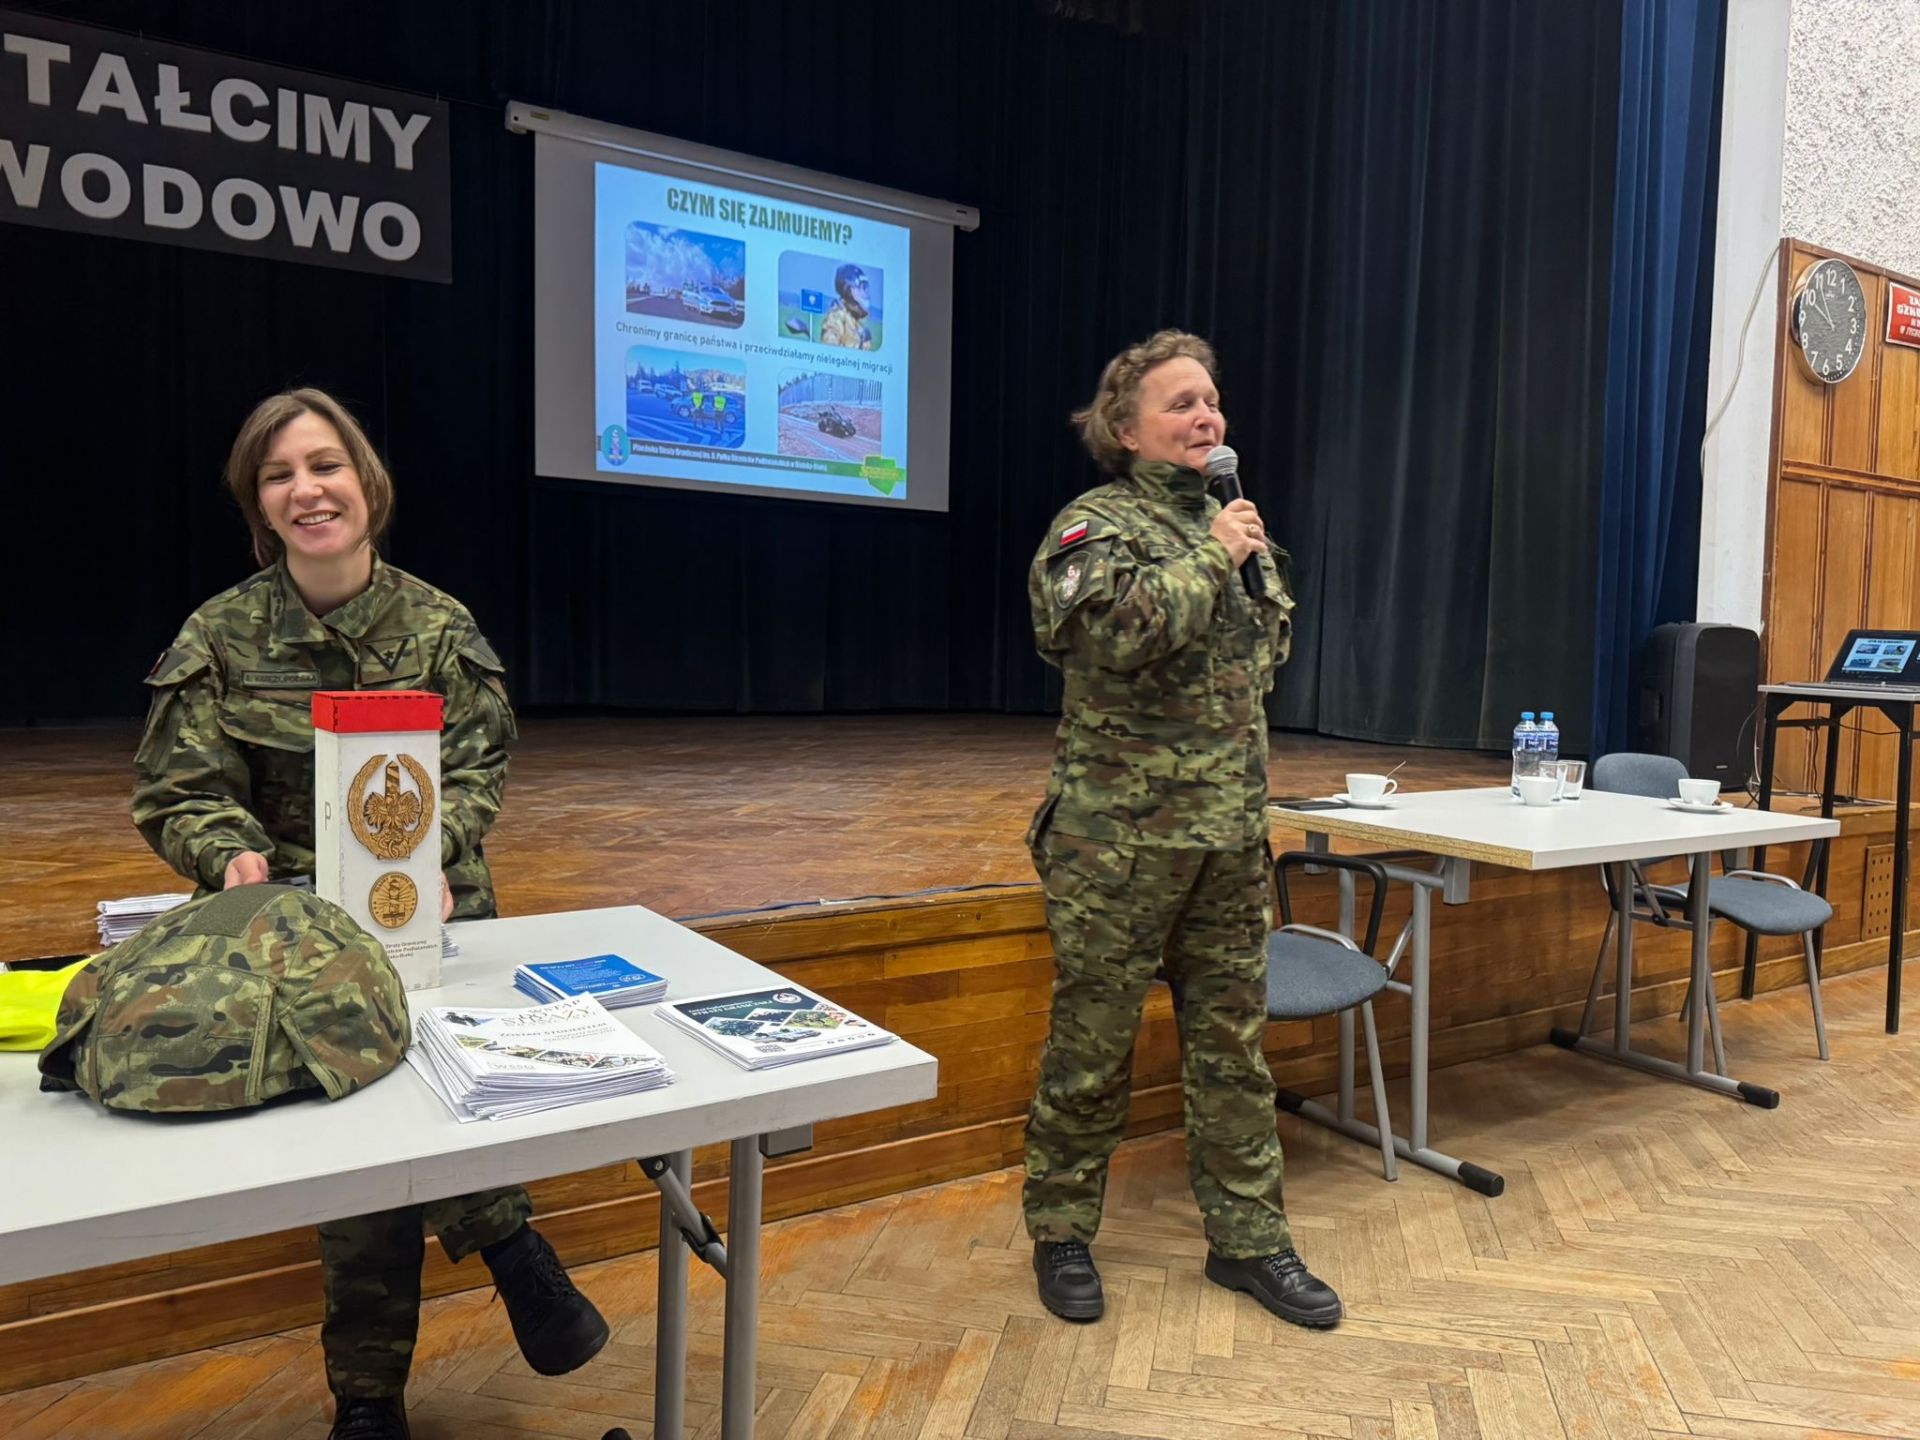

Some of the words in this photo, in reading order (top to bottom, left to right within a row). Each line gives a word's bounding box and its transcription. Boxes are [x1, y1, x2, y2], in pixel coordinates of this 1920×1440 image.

[3, 33, 431, 171] TAŁCIMY
[666, 187, 715, 218] CZYM
[719, 199, 746, 229] SIĘ
[748, 203, 853, 245] ZAJMUJEMY?
[1826, 268, 1837, 287] 12
[1840, 277, 1846, 294] 1
[1804, 288, 1816, 306] 10
[1848, 295, 1855, 312] 2
[1799, 310, 1806, 327] 9
[1850, 317, 1857, 334] 3
[616, 321, 662, 343] Chronimy
[663, 328, 698, 346] granicę
[700, 333, 737, 352] państwa
[744, 342, 815, 364] przeciwdziałamy
[816, 352, 862, 372] nielegalnej
[862, 358, 893, 375] migracji
[1802, 332, 1808, 349] 8
[1845, 338, 1852, 354] 4
[1811, 350, 1819, 368] 7
[1822, 358, 1829, 375] 6
[1836, 354, 1843, 371] 5
